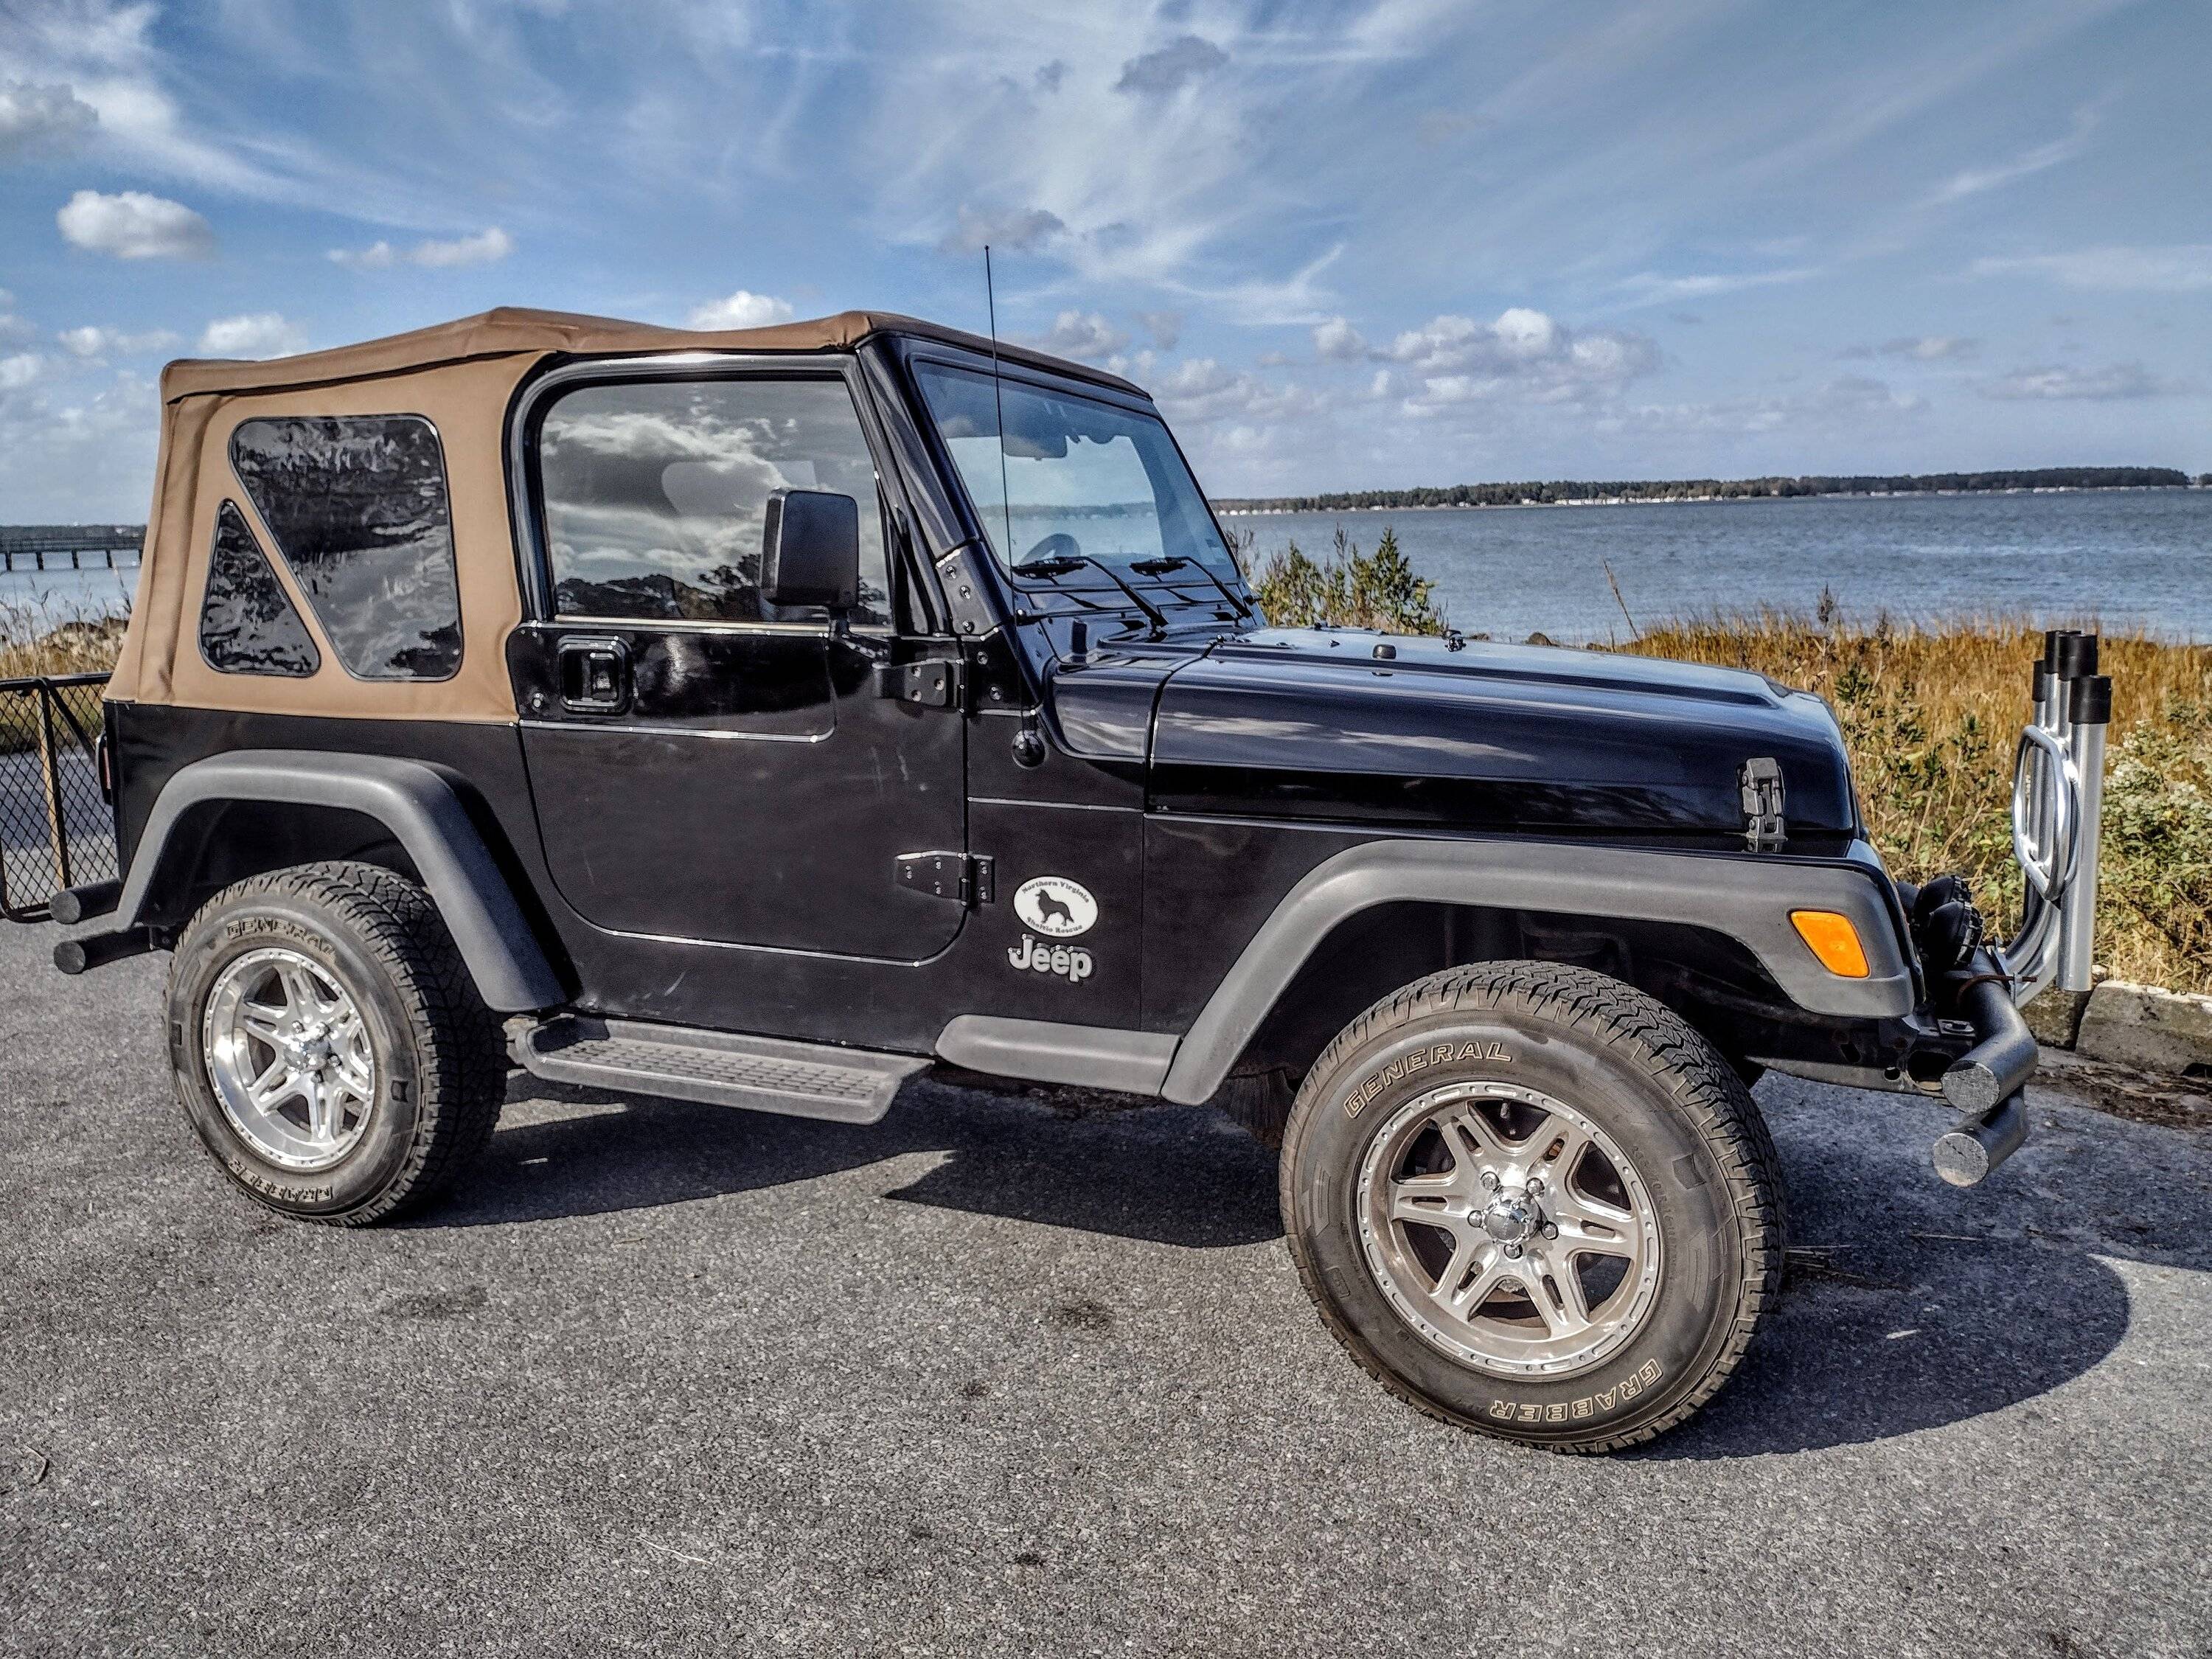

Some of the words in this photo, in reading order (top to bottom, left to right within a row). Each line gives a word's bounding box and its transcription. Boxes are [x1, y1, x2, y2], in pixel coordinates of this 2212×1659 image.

[1021, 880, 1058, 894] Northern
[1060, 881, 1089, 903] Virginia
[1008, 933, 1093, 983] Jeep
[1343, 1040, 1512, 1119] GENERAL
[1489, 1357, 1663, 1423] GRABBER
